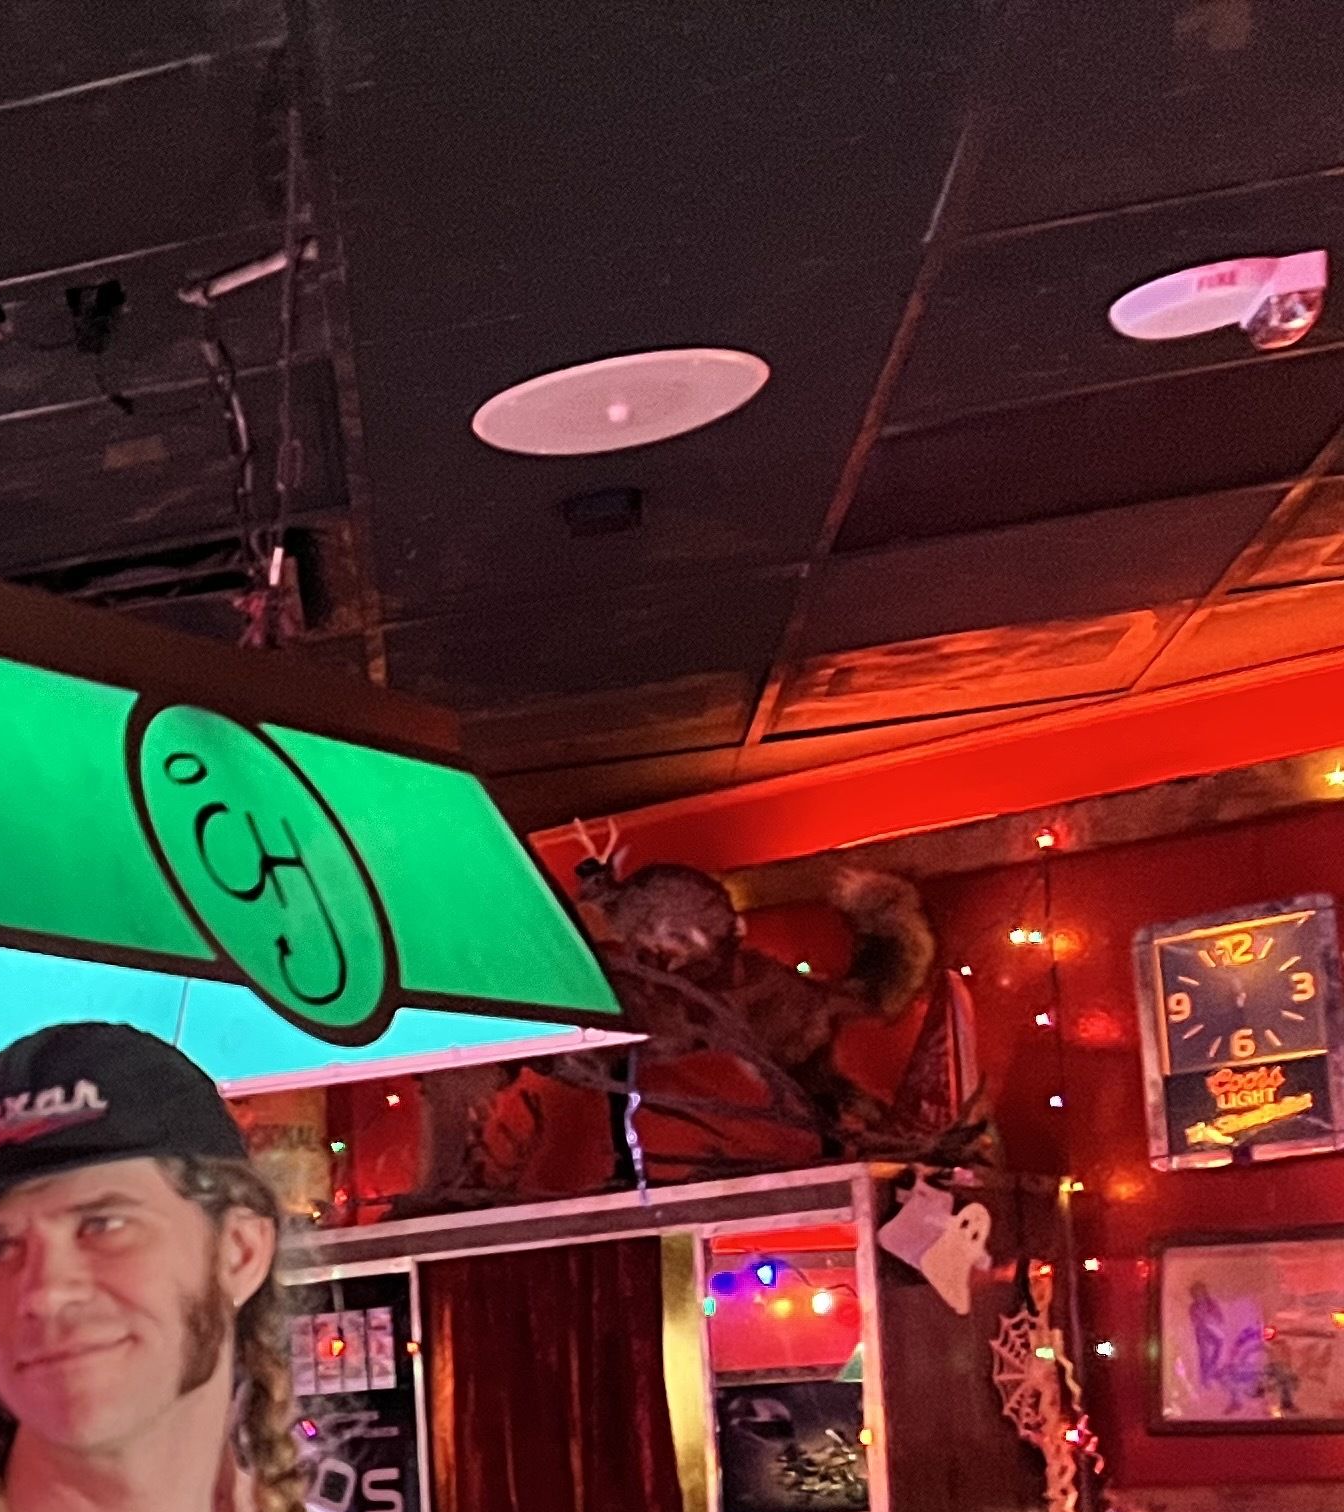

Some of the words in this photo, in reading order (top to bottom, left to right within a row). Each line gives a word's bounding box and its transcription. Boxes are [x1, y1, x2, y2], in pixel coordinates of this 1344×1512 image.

[1216, 932, 1253, 965] 12
[1290, 971, 1315, 1002] 3
[1168, 992, 1191, 1023] 9
[1230, 1028, 1256, 1058] 6
[1218, 1088, 1277, 1109] LIGHT
